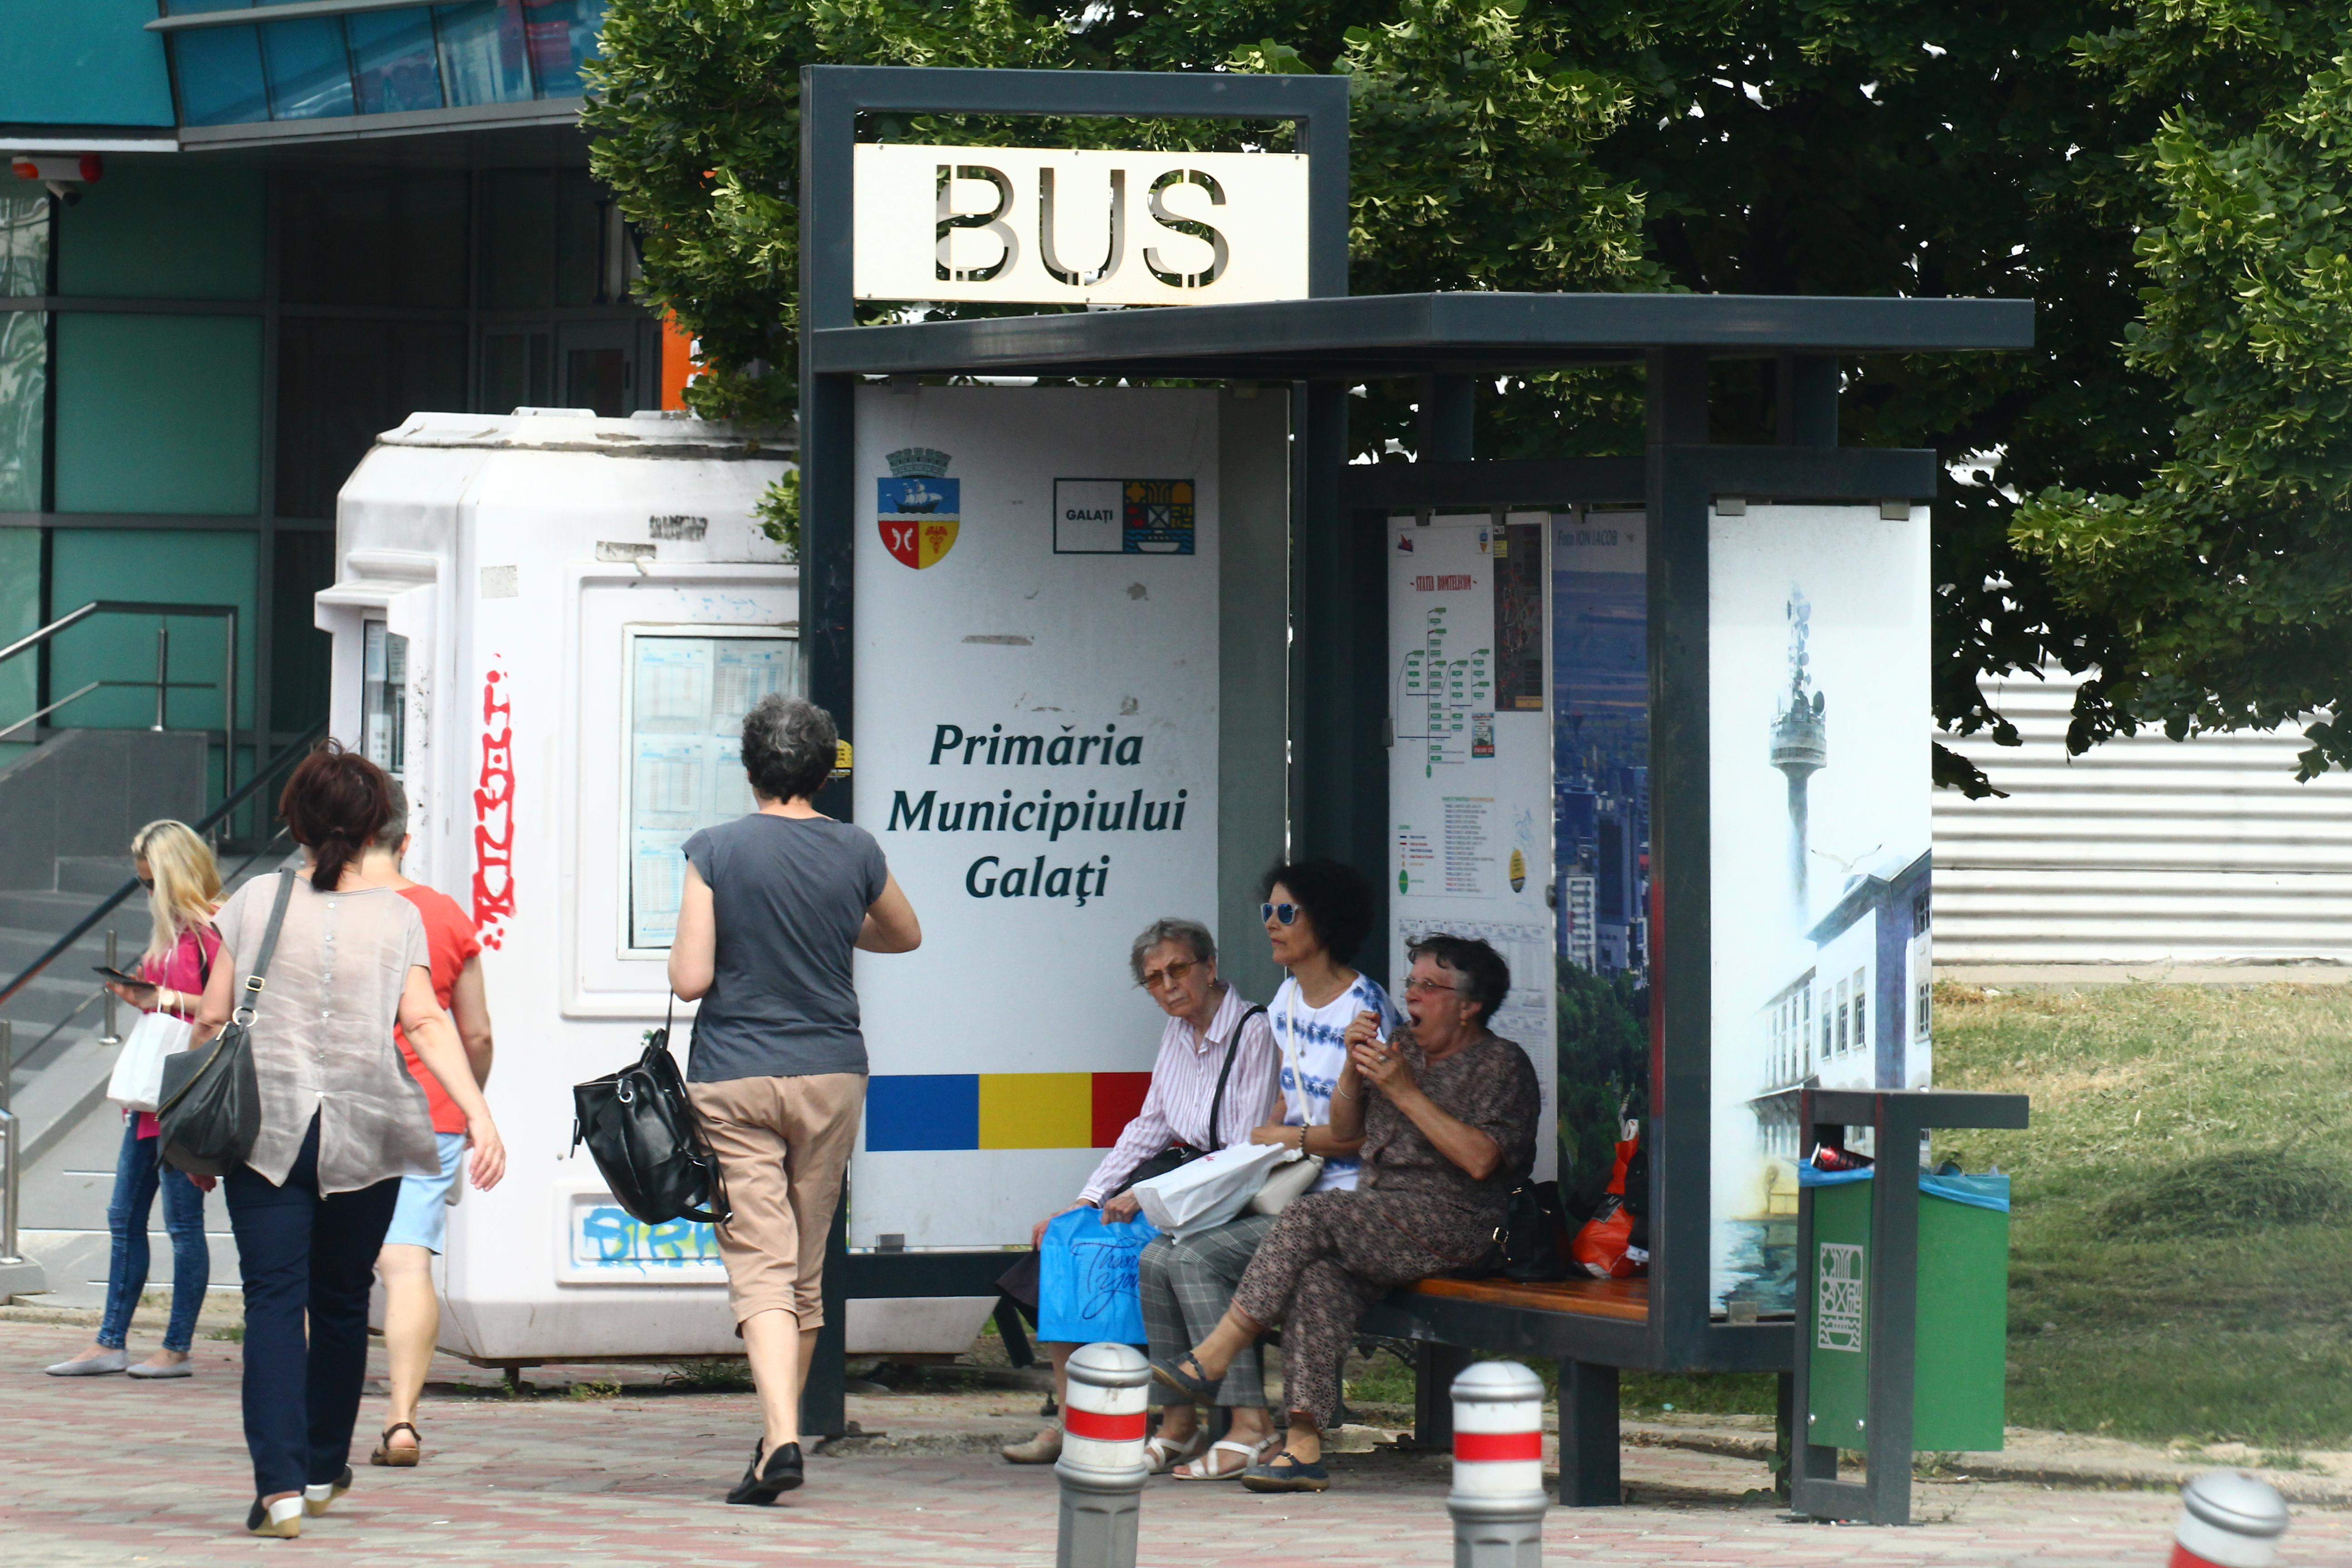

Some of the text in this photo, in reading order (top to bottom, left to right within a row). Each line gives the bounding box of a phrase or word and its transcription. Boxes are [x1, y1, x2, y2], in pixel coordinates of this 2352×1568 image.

[936, 164, 1230, 289] BUS
[929, 723, 1144, 766] Primăria
[887, 789, 1188, 842] Municipiului
[1070, 1237, 1139, 1295] Than
